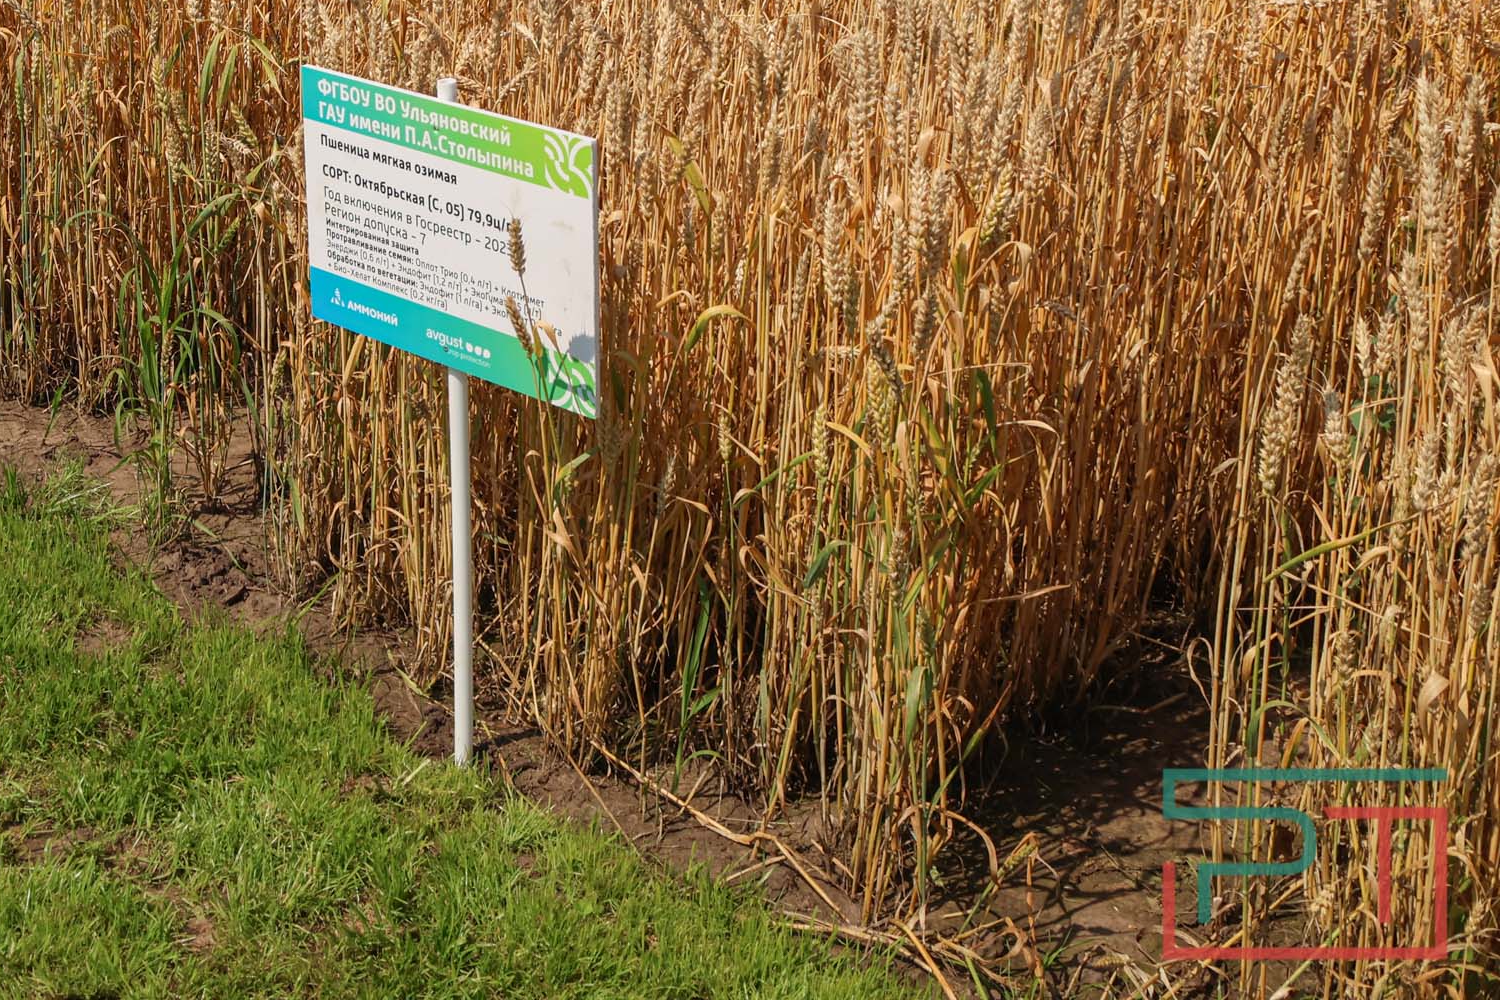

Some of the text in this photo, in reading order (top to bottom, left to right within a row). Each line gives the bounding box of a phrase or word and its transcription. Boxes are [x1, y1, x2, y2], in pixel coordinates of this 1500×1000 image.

[316, 76, 511, 148] ФГБОУ ВО Ульяновский
[318, 100, 533, 179] ГАУ имени П.А.Столыпина
[320, 133, 457, 186] Пшеница мягкая озимая
[322, 163, 352, 184] СОРТ:
[353, 172, 424, 207] Октябрьская
[467, 206, 511, 235] 79,9ц/г
[323, 185, 341, 204] Год
[343, 193, 403, 223] включения
[405, 212, 413, 225] в
[414, 214, 472, 246] Госреестр
[324, 202, 361, 226] Регион
[363, 216, 408, 241] допуска
[419, 232, 427, 247] 7
[325, 217, 419, 258] Интегрированная защита
[326, 228, 386, 257] Протравливание
[388, 249, 414, 266] семян:
[326, 249, 364, 270] Обработка
[365, 264, 375, 274] по
[376, 267, 418, 289] вегетации:
[346, 299, 398, 328] АММОНИЙ
[426, 328, 464, 350] avgust
